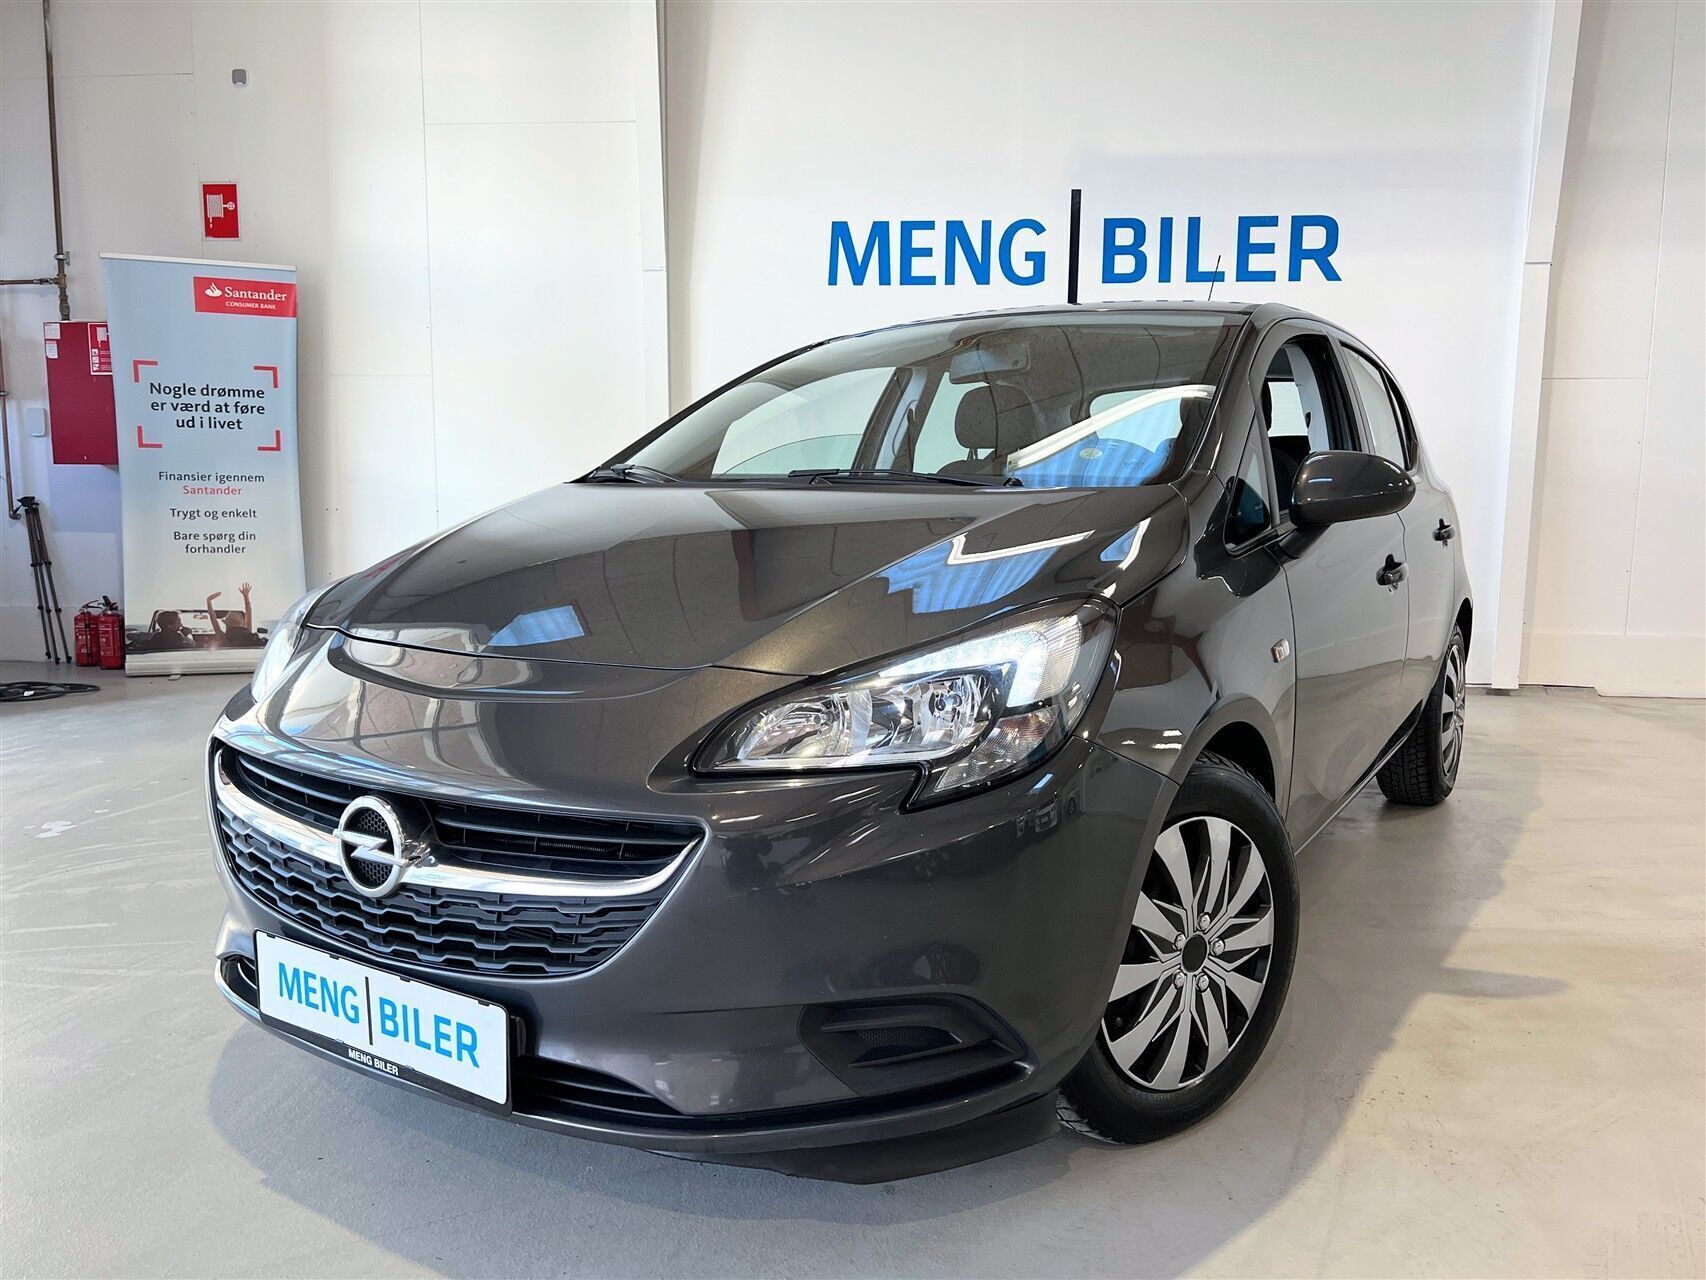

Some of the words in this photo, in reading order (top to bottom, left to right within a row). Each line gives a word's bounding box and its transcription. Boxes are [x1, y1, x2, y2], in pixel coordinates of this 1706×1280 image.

[828, 218, 1047, 287] MENG
[1101, 214, 1342, 285] BILER
[224, 286, 288, 302] Santander
[225, 301, 259, 309] CONSUMER
[149, 382, 197, 400] Nogle
[200, 383, 265, 399] drømme
[150, 401, 168, 412] er
[170, 399, 211, 413] værd
[214, 402, 231, 414] at
[233, 400, 266, 415] føre
[176, 415, 196, 429] ud
[199, 416, 204, 429] i
[208, 416, 243, 430] livet
[158, 471, 212, 482] Finansier
[215, 471, 265, 486] igennem
[183, 485, 242, 496] Santander
[169, 508, 201, 521] Trygt
[204, 510, 219, 521] og
[221, 508, 257, 519] enkelt
[173, 531, 200, 541] Bare
[203, 533, 236, 544] spørg
[238, 531, 256, 541] din
[185, 543, 247, 554] forhandler
[278, 962, 361, 1025] MENG
[379, 996, 480, 1069] BILER
[348, 1048, 373, 1066] MENG
[374, 1058, 399, 1076] BILER
